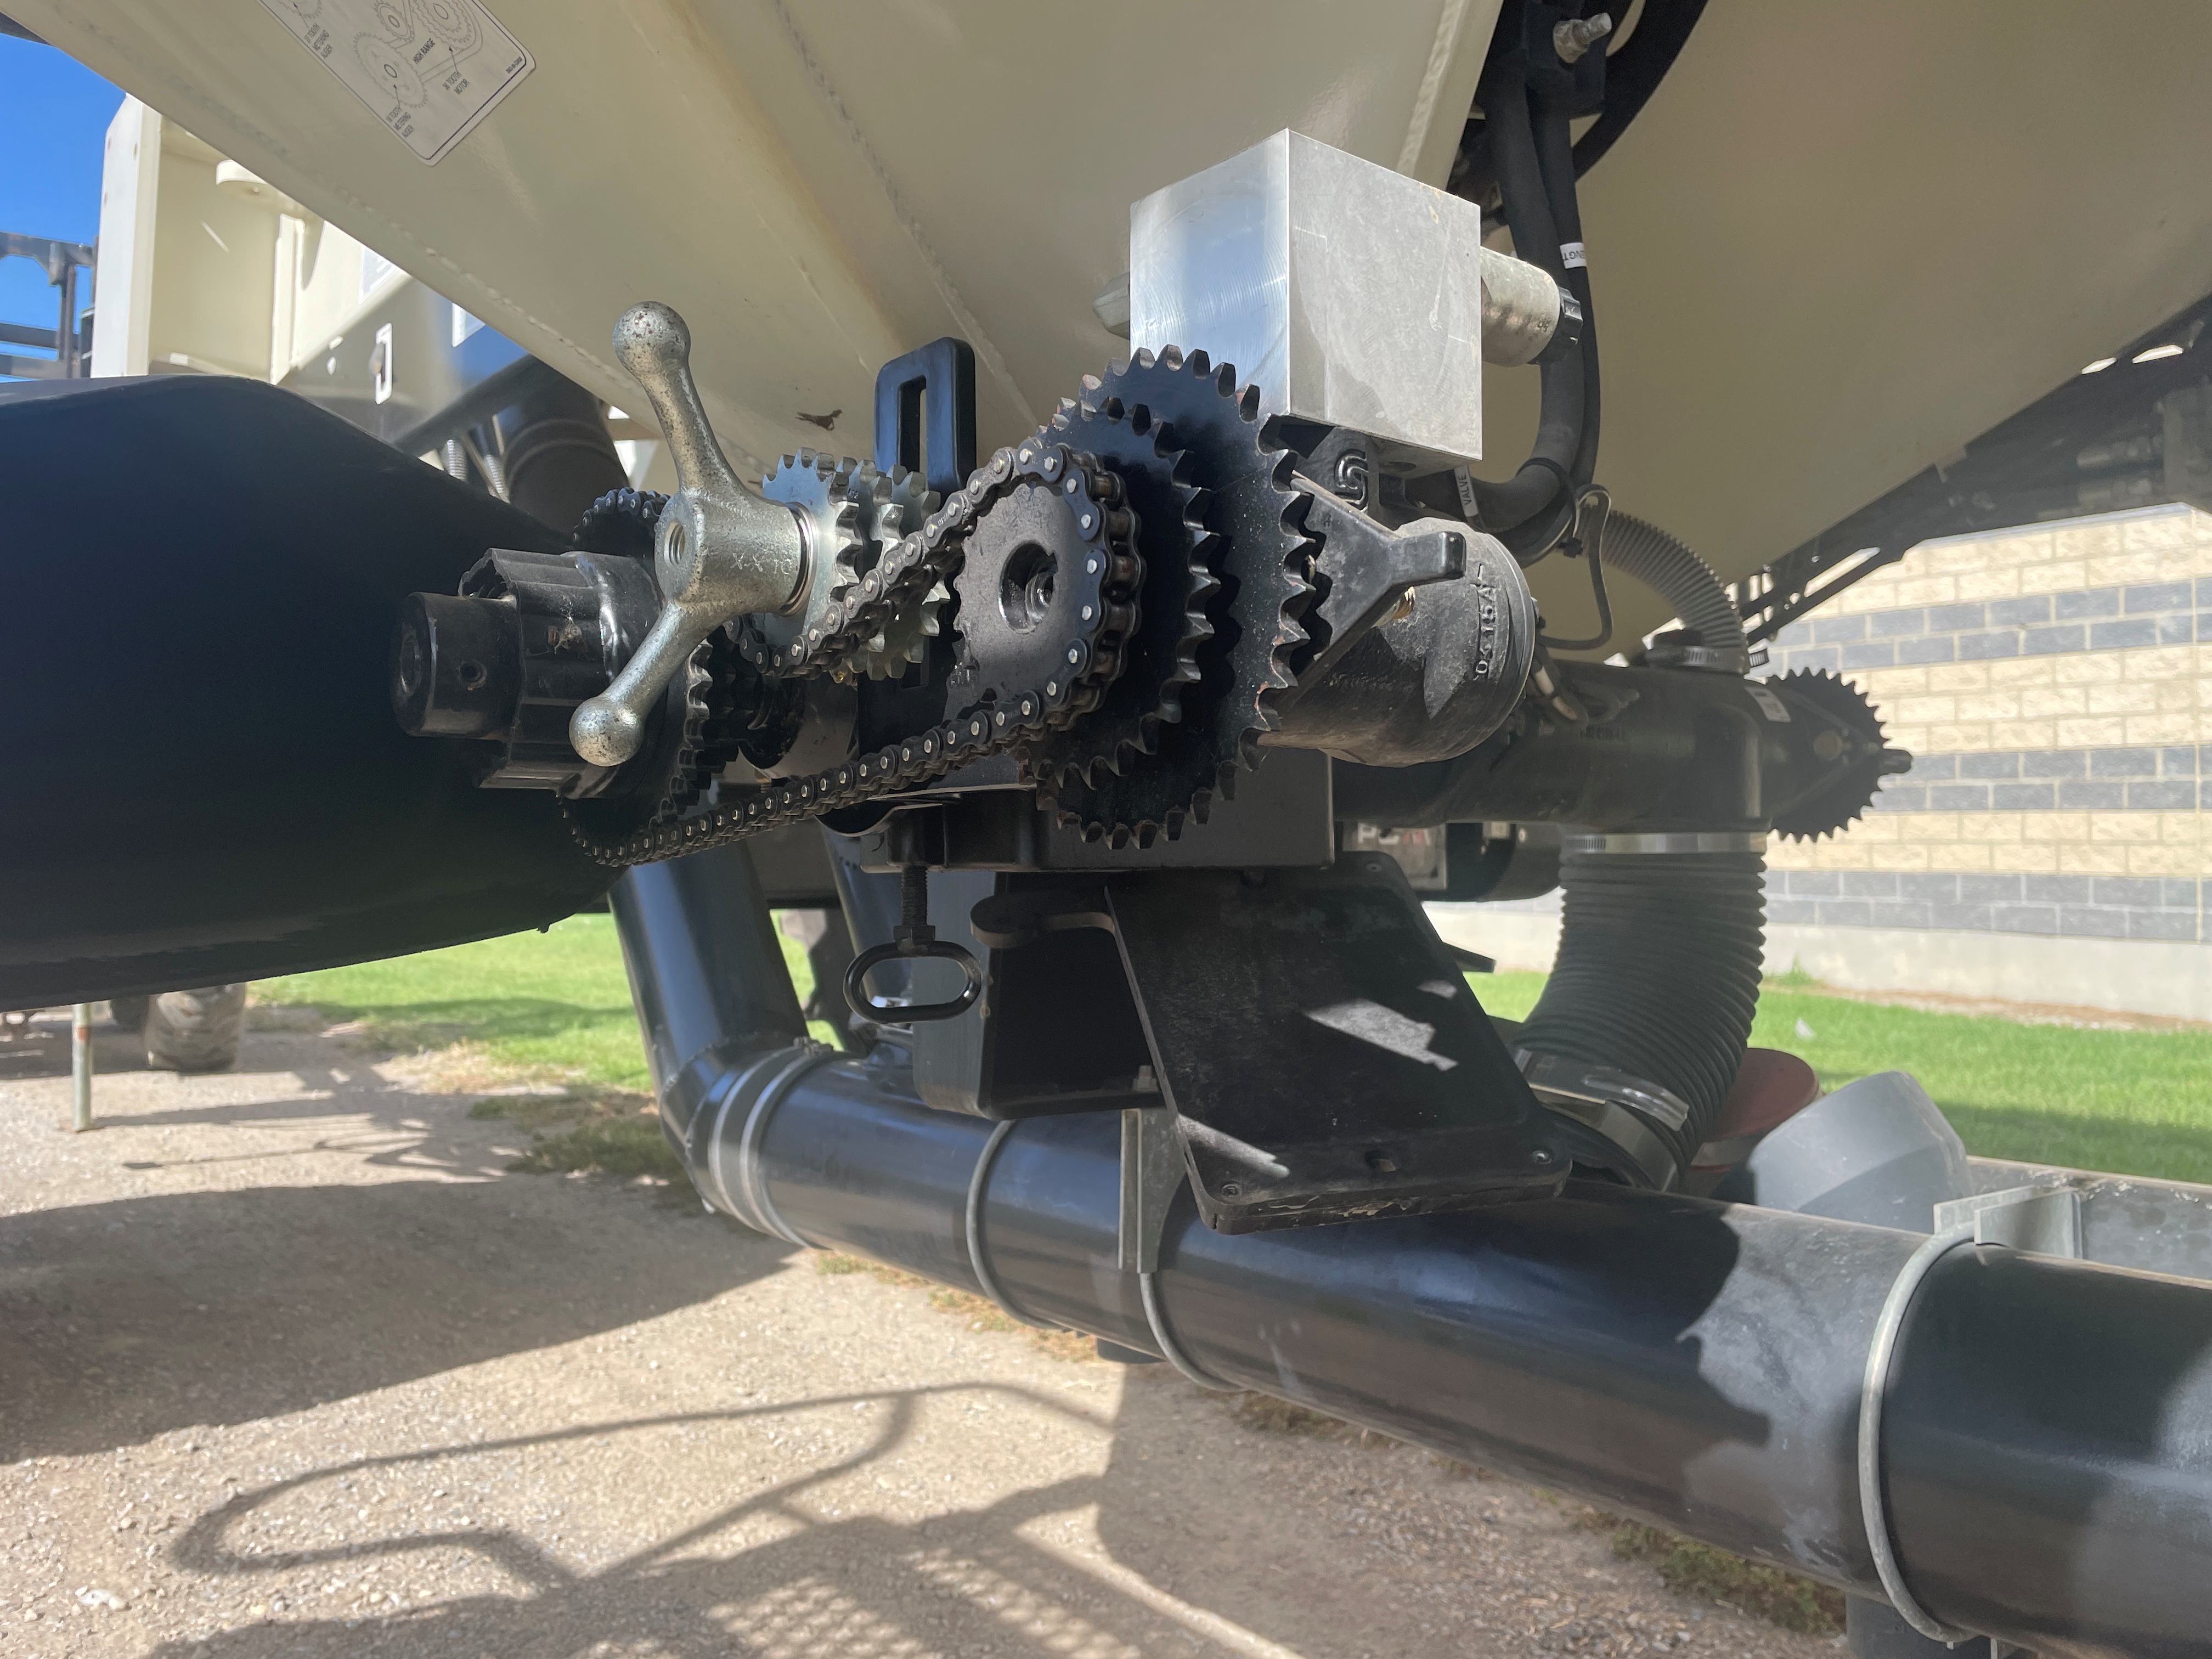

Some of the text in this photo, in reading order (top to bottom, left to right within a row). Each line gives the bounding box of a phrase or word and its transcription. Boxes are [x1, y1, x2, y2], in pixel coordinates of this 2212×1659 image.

[312, 30, 330, 50] METERING
[419, 37, 436, 55] RANGE
[321, 44, 334, 59] AUGER
[446, 70, 461, 86] TOOTH
[454, 78, 470, 95] MOTOR
[393, 111, 411, 131] METERING
[402, 125, 415, 138] AUGER
[1458, 474, 1472, 505] VALVE
